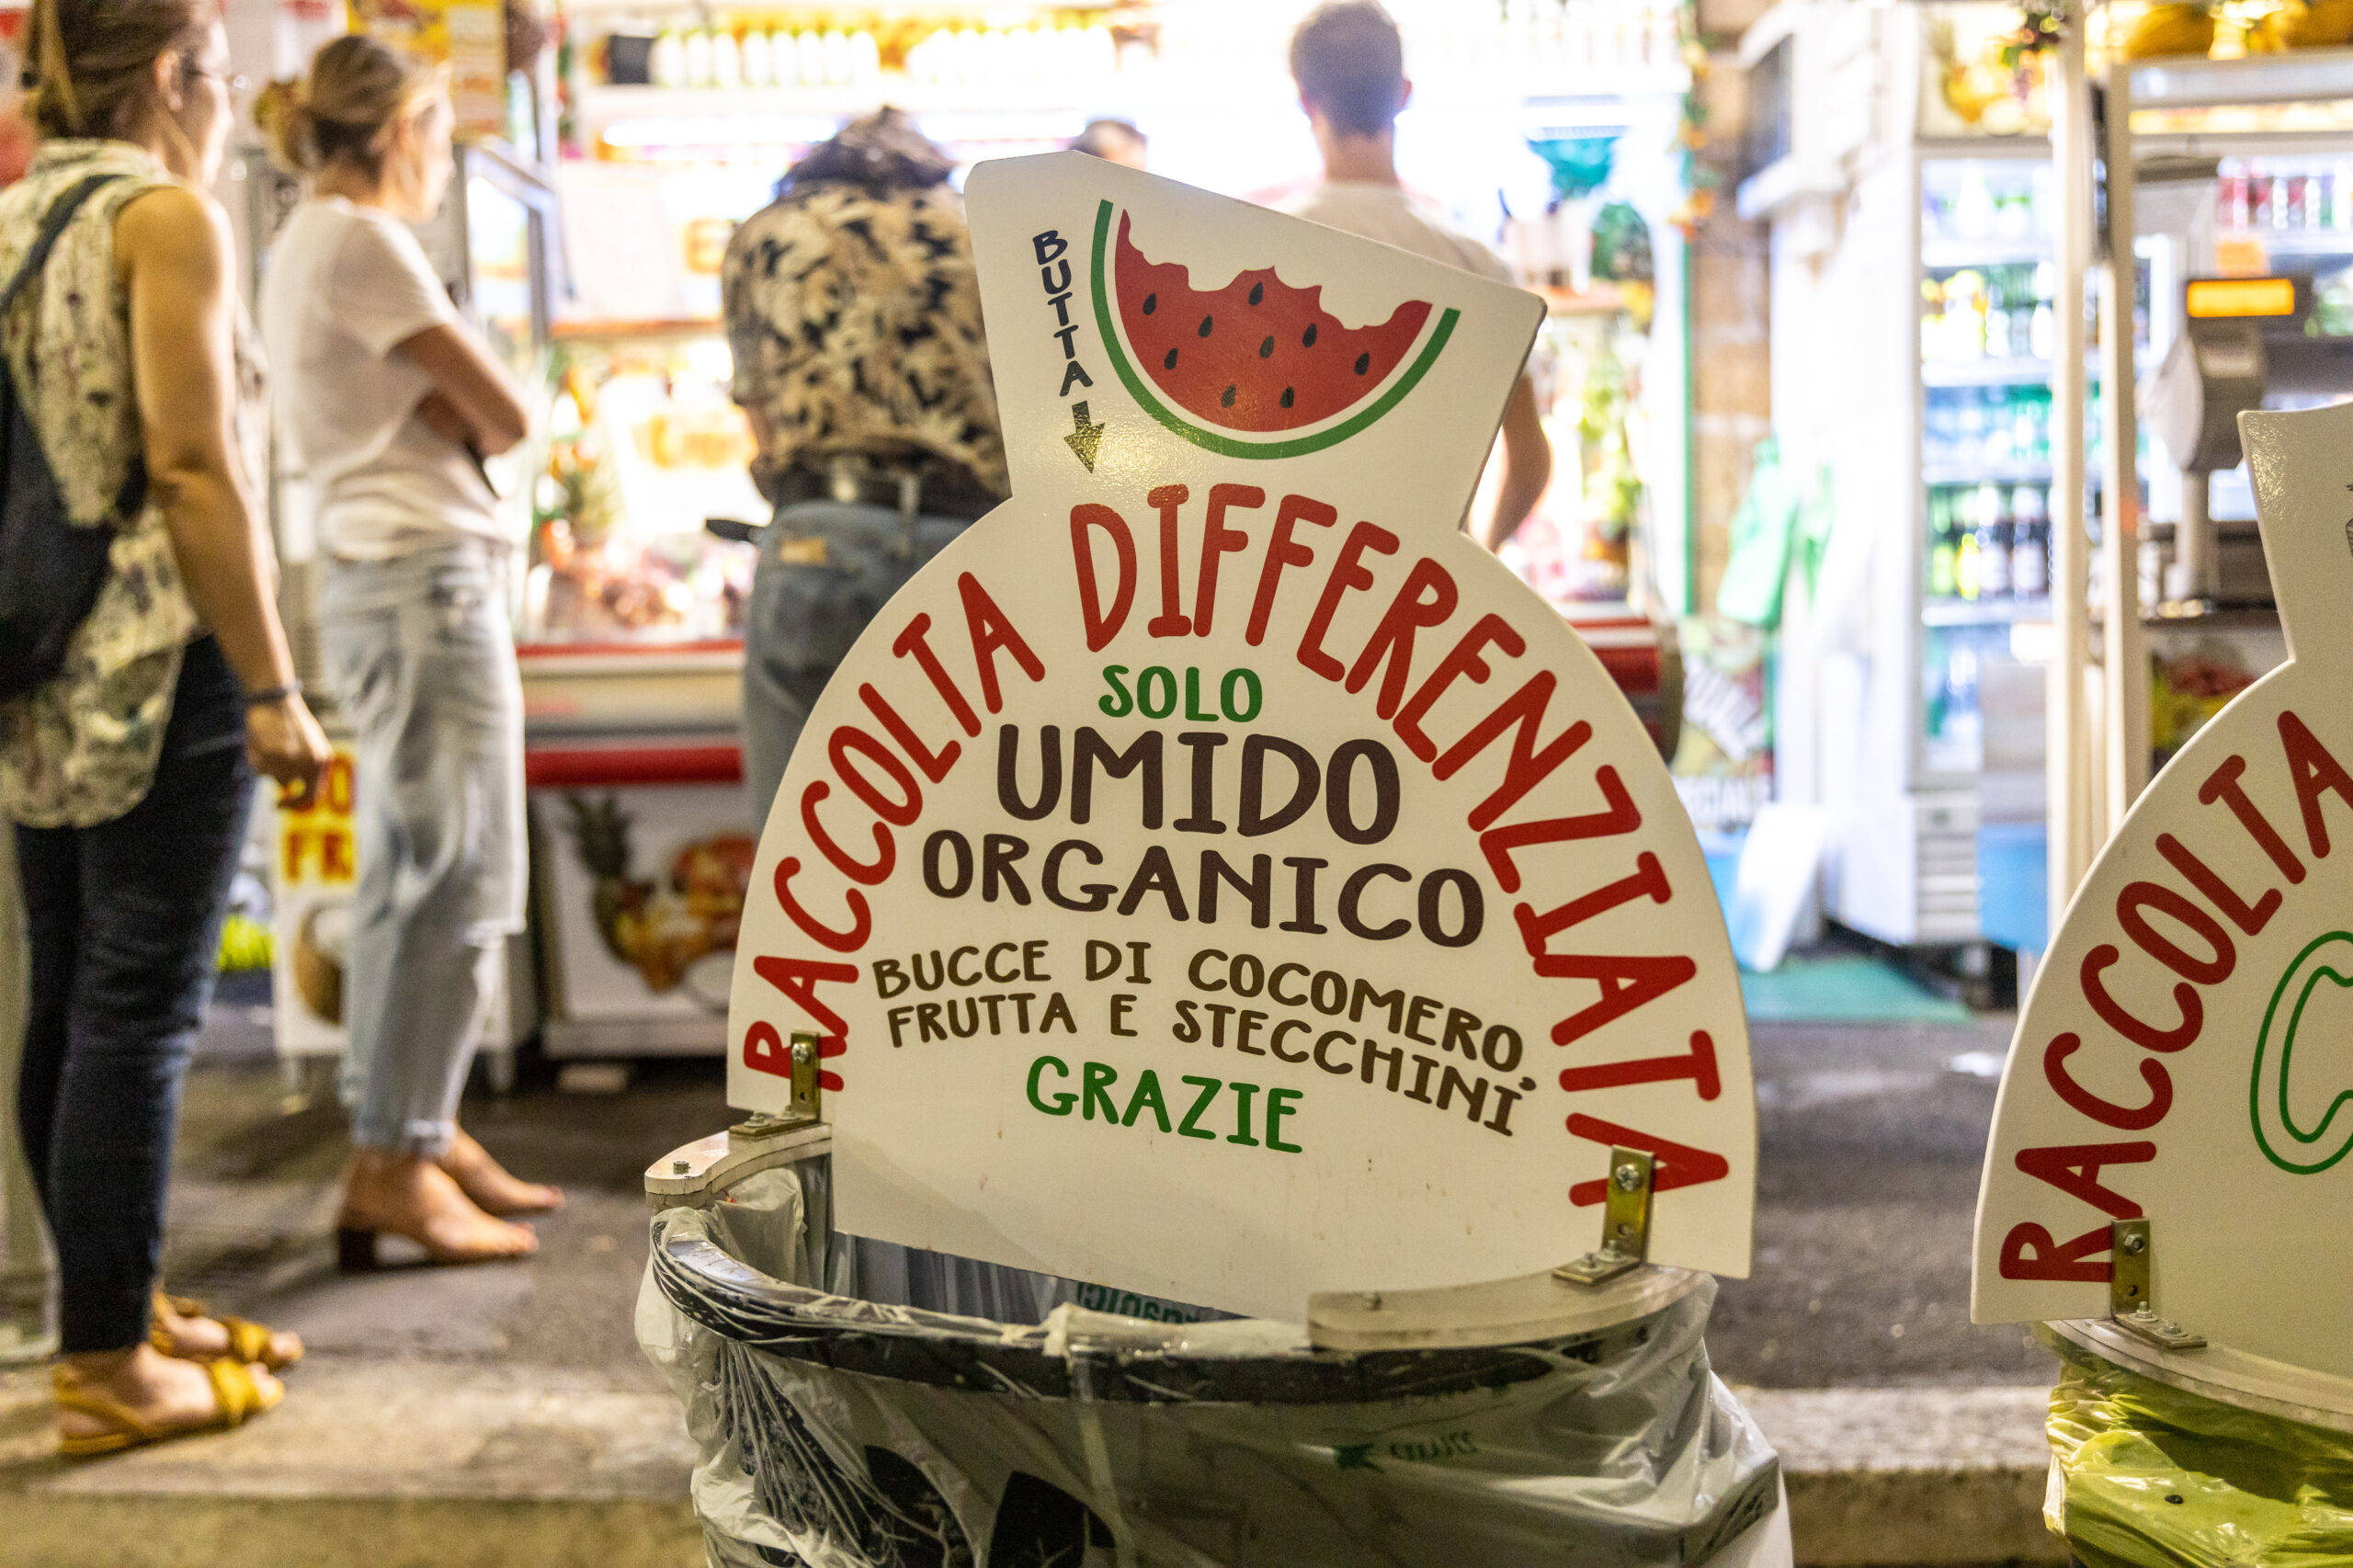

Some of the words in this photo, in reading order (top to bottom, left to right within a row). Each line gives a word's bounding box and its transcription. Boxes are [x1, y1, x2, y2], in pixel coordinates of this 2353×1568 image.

[1032, 230, 1094, 398] BUTTA
[1098, 665, 1263, 722] SOLO
[743, 571, 1045, 1093] RACCOLTA
[1070, 483, 1730, 1208] DIFFERENZIATA
[996, 723, 1401, 846] UMIDO
[922, 829, 1485, 949] ORGANICO
[871, 939, 1052, 1000] BUCCE
[1085, 939, 1153, 985] DI
[1999, 710, 2353, 1283] RACCOLTA
[887, 992, 1078, 1049] FRUTTA
[1109, 994, 1139, 1038] E
[1172, 999, 1524, 1137] STECCHINI
[1026, 1055, 1304, 1153] GRAZIE
